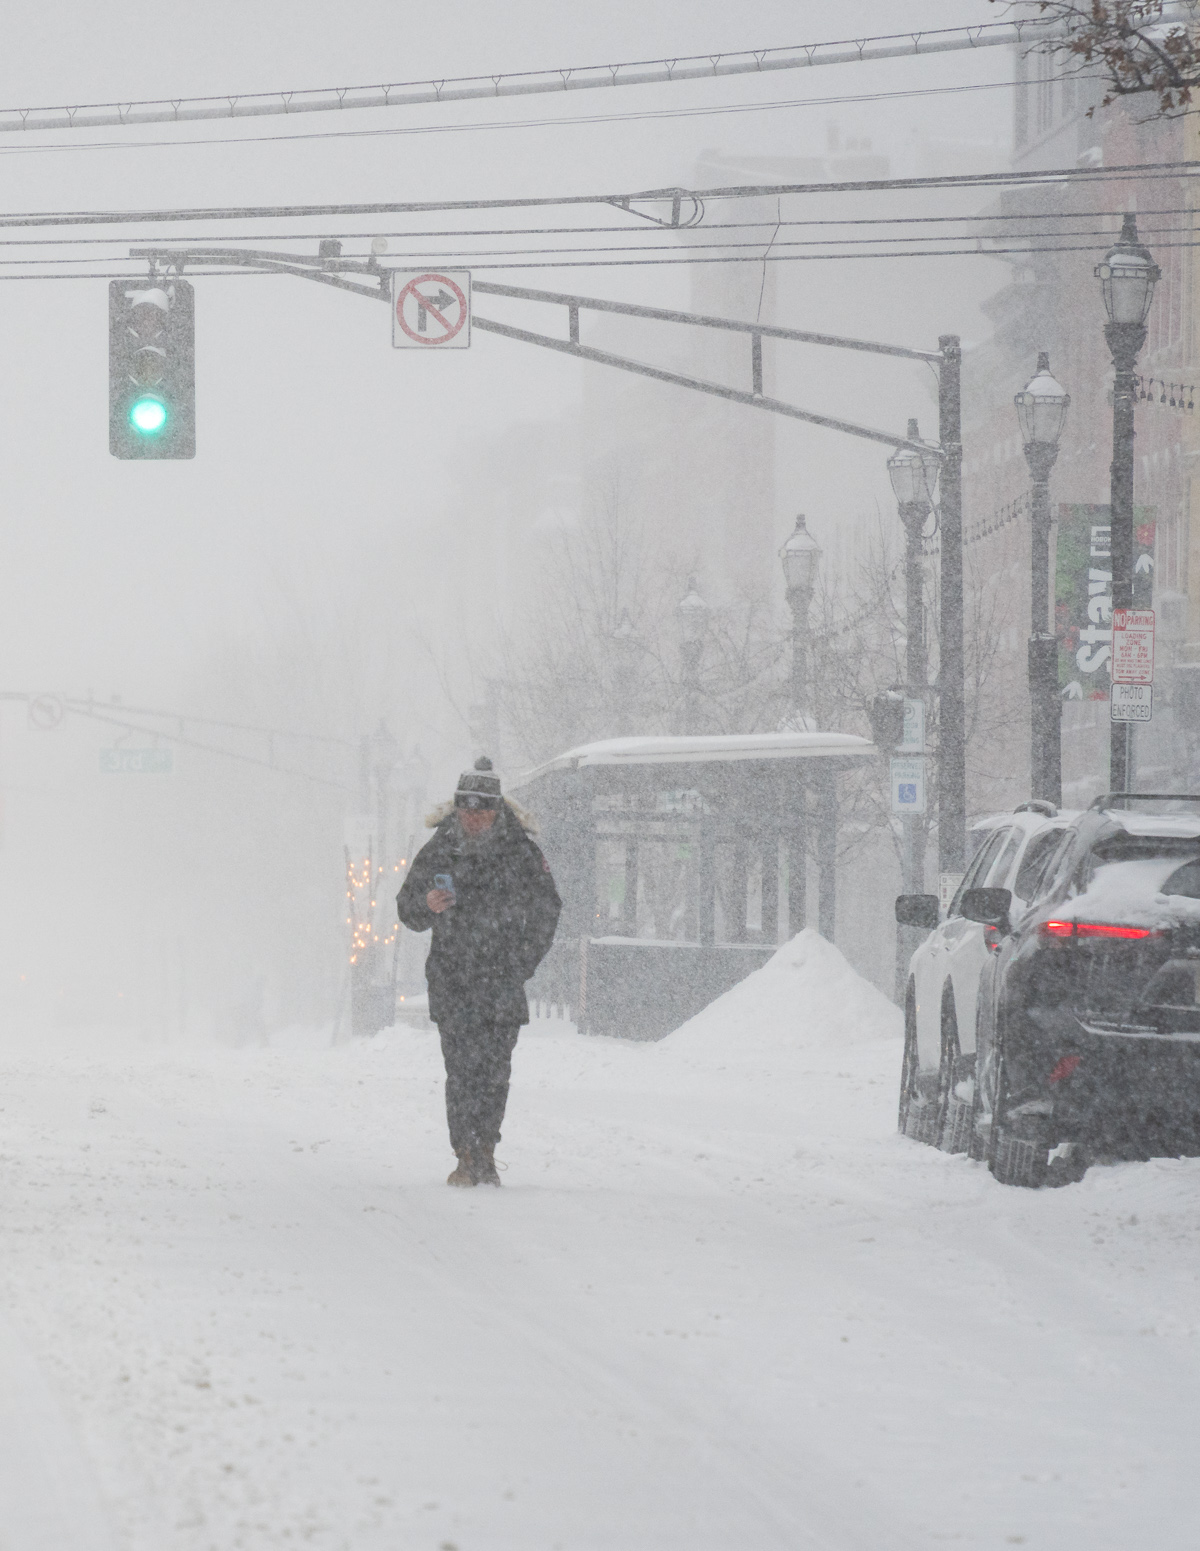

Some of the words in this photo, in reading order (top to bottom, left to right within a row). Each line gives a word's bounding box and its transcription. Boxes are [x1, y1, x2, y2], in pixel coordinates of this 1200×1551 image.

[1114, 612, 1126, 627] NO
[1126, 615, 1154, 625] PARKING
[1120, 686, 1143, 699] PHOTO
[1113, 704, 1149, 718] ENFORCED
[108, 752, 143, 770] 3rd
